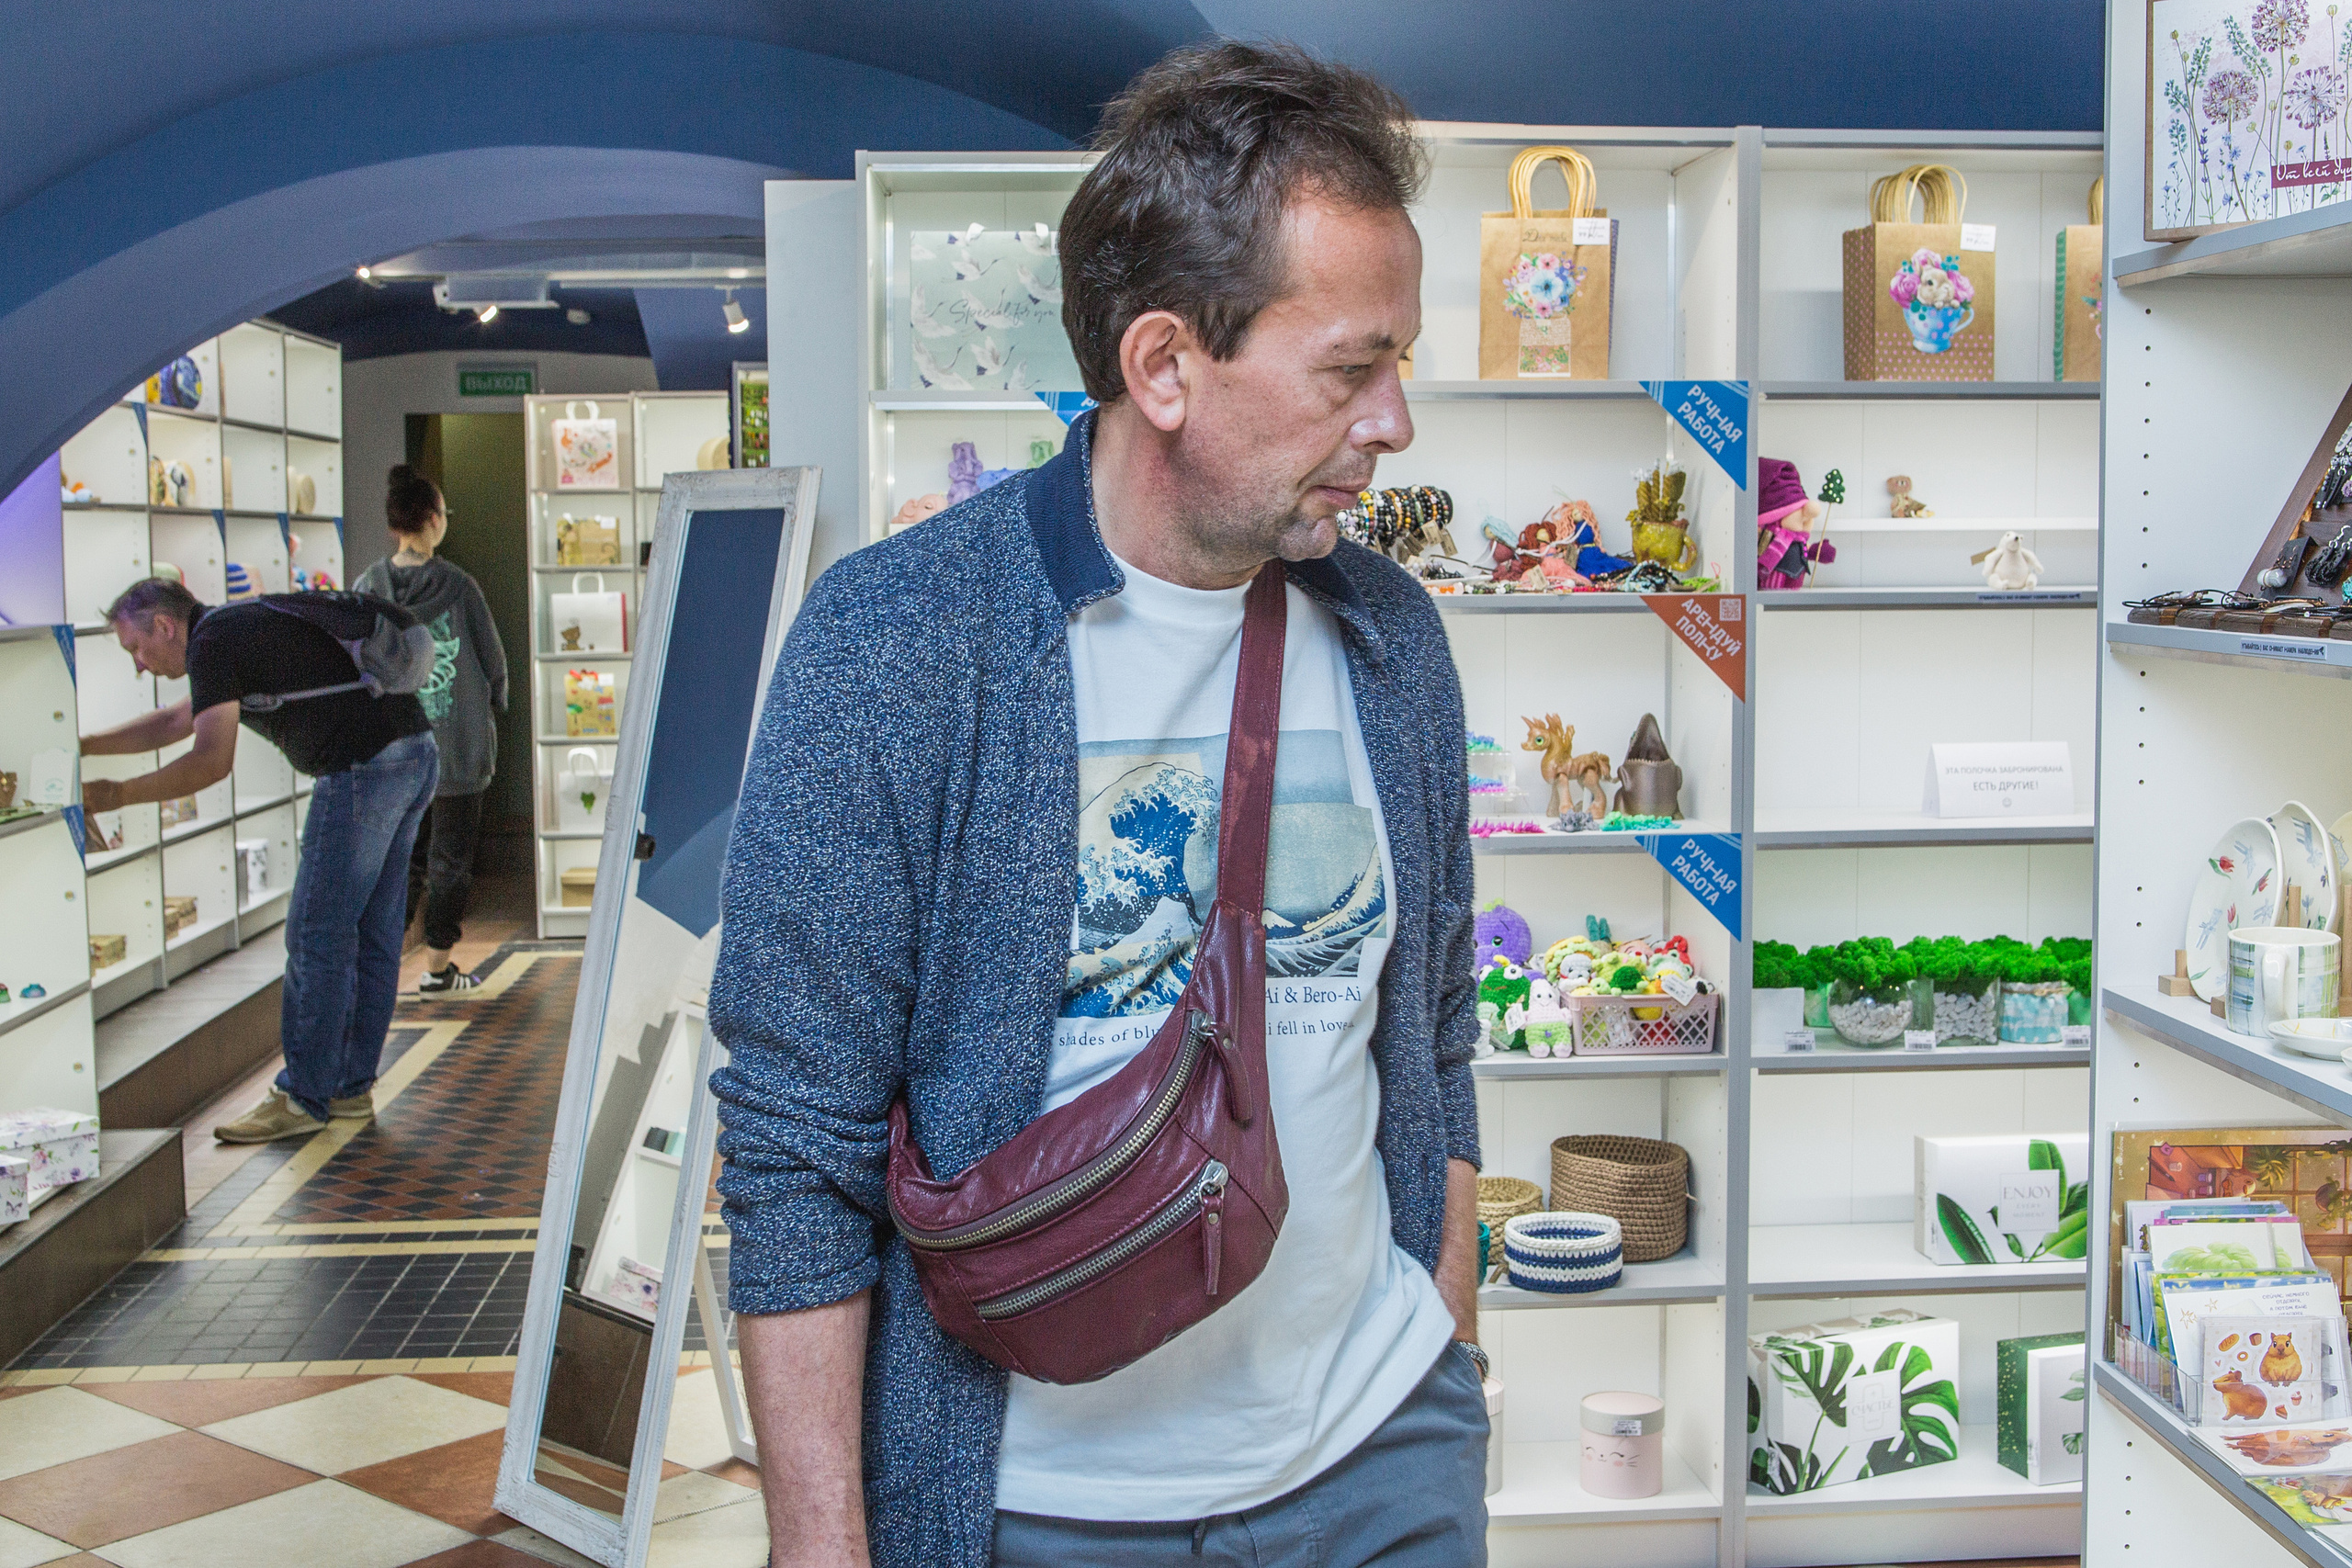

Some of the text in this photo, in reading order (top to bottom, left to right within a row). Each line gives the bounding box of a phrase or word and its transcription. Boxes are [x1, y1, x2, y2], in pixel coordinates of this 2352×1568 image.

[2277, 161, 2300, 181] От
[2303, 160, 2331, 178] всей
[949, 299, 1011, 323] Special
[1035, 310, 1056, 323] you
[465, 376, 526, 391] ВЫХОД
[1687, 384, 1743, 444] РУЧНАЯ
[1677, 401, 1725, 455] РАБОТА
[1675, 615, 1724, 660] ПОЛКУ
[1680, 598, 1742, 657] АРЕНДУЙ
[1945, 765, 2064, 774] ЭТА ПОЛОЧКА ЗАБРОНИРОВАНА
[1973, 781, 2039, 792] ЕСТЬ ДРУГИЕ!
[1681, 838, 1737, 895] РУЧНАЯ
[1670, 854, 1720, 906] РАБОТА
[1284, 987, 1298, 1003] &
[1303, 986, 1363, 1003] Bero-Ai
[1058, 1032, 1104, 1046] shades
[1112, 1029, 1129, 1043] of
[1277, 1021, 1298, 1035] fell
[1302, 1021, 1317, 1033] in
[2003, 1185, 2054, 1200] ENJOY
